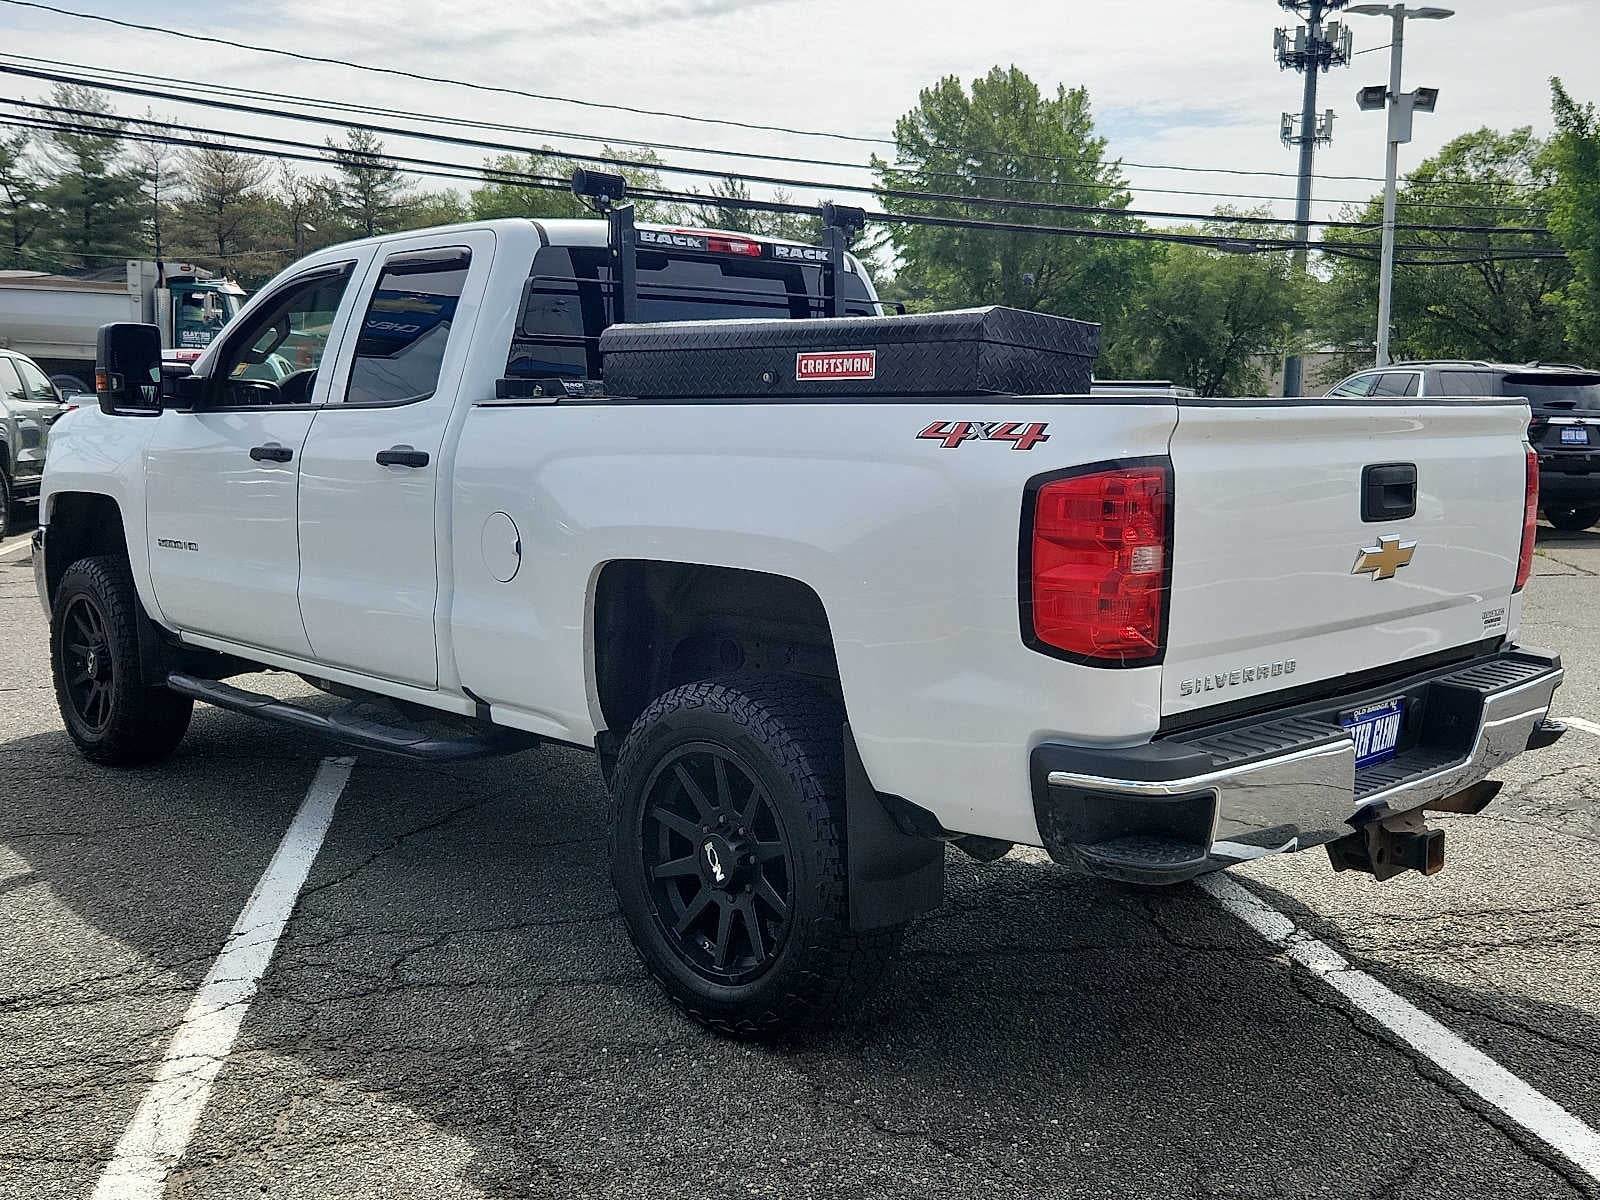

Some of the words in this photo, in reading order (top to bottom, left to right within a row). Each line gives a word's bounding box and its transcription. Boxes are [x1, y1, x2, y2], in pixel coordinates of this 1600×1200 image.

[639, 231, 702, 248] BACK
[775, 246, 829, 261] RACK
[801, 358, 871, 373] CRAFTSMAN
[1179, 658, 1297, 697] SILVERADO
[1371, 713, 1400, 753] GLENN
